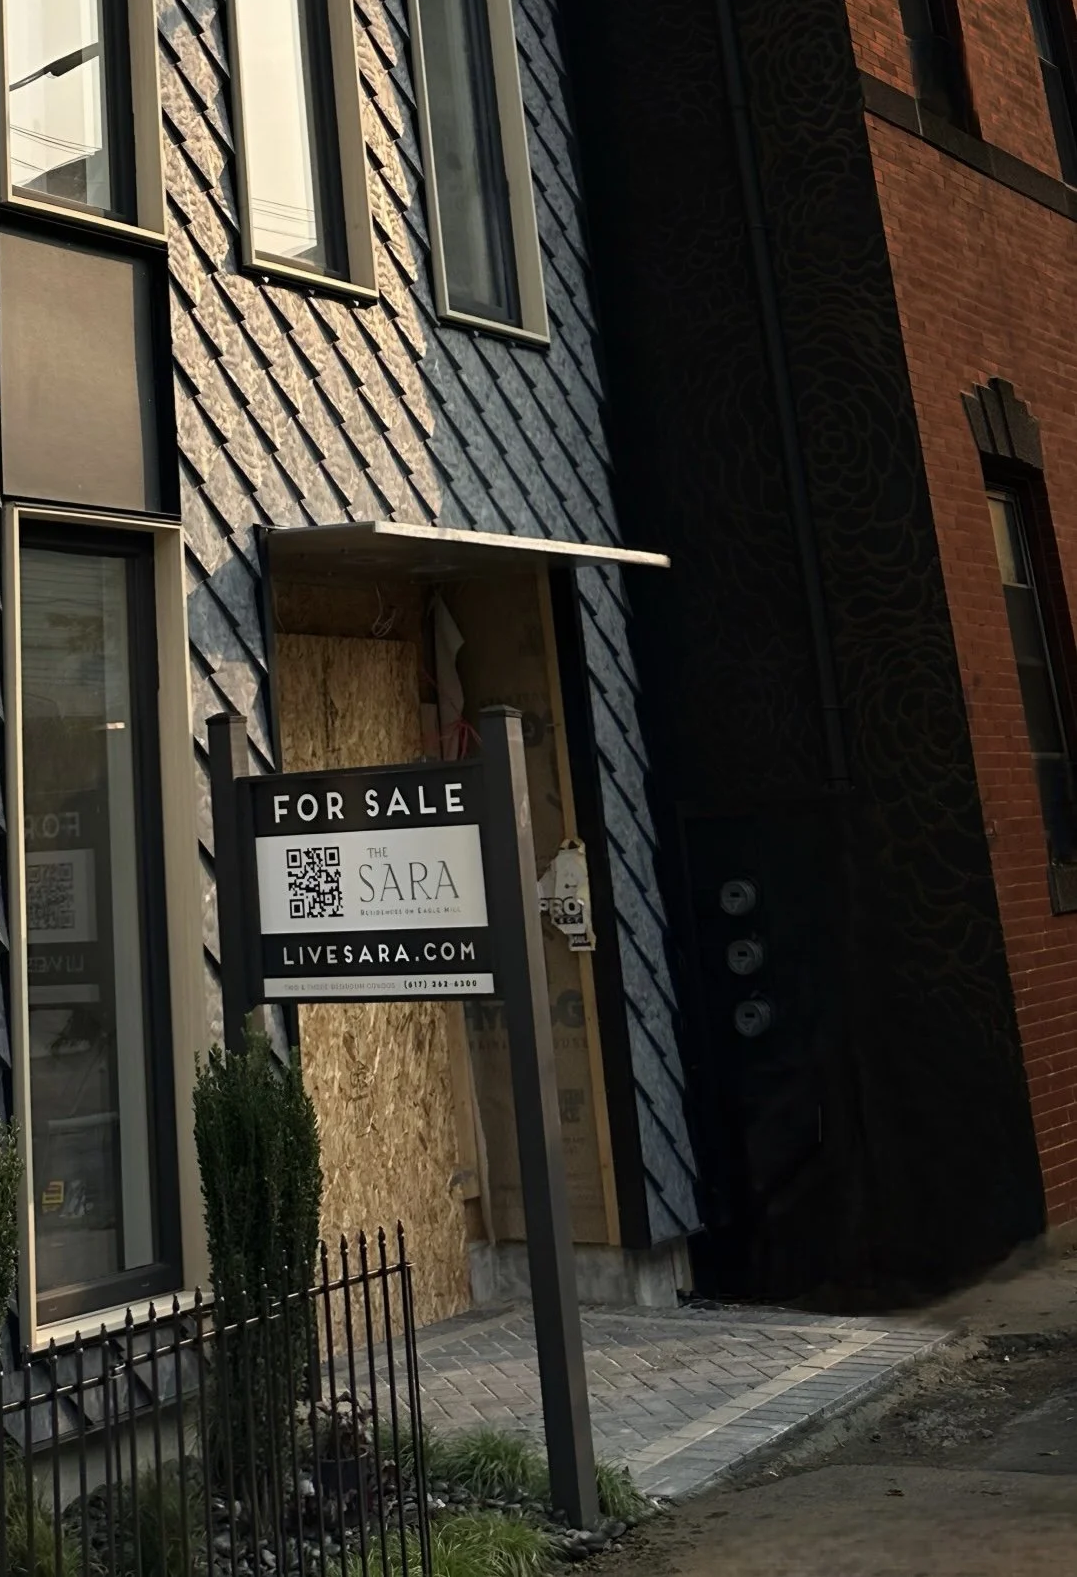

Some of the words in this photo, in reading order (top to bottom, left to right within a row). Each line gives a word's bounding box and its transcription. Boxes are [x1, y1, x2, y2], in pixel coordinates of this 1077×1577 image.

[273, 791, 345, 824] FOR
[365, 783, 464, 817] SALE
[367, 847, 388, 859] THE
[358, 860, 460, 903] SARA
[283, 941, 475, 965] LIVESARA.COM
